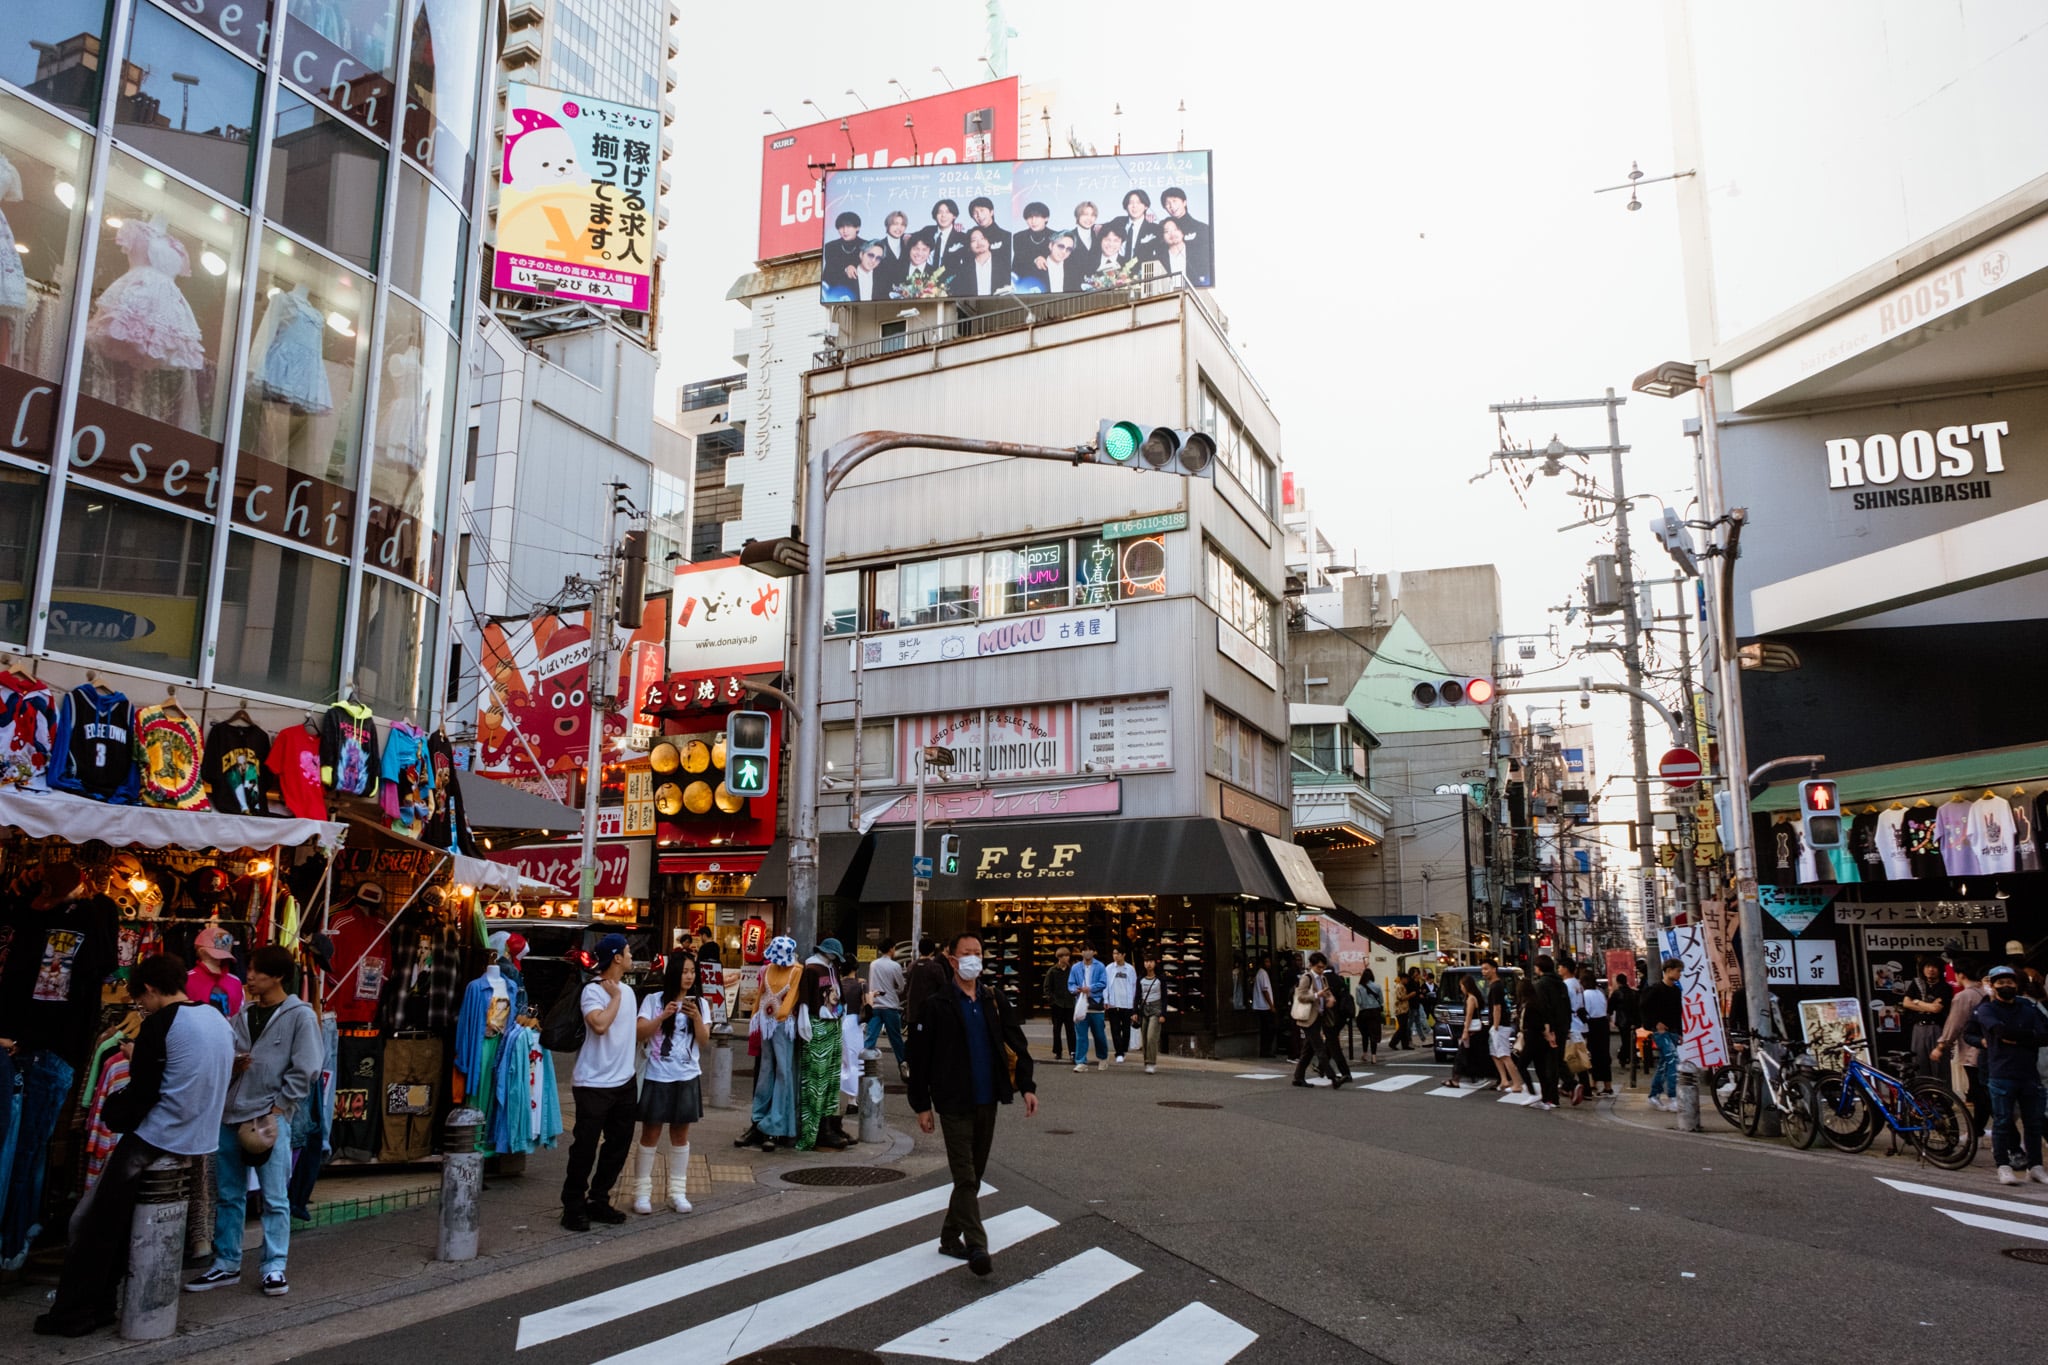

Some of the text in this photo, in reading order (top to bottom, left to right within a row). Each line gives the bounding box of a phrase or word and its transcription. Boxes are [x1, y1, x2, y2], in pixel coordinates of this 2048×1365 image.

[582, 107, 653, 129] いちごなび
[773, 138, 796, 150] KURE
[1129, 159, 1193, 173] 2024.4.24
[939, 169, 1001, 183] 2024.4.24
[1129, 174, 1193, 188] RELEASE
[587, 132, 620, 261] 揃ってます。
[938, 184, 1001, 198] RELEASE
[617, 137, 651, 265] 稼げる求人
[518, 270, 615, 297] いちなび 体入
[1878, 266, 1967, 335] ROOST
[1825, 421, 2009, 490] ROOST
[1853, 480, 1992, 510] SHINSAIBASHI
[1121, 513, 1185, 532] 06-6110-8188
[977, 615, 1047, 656] MUMU
[1059, 618, 1101, 640] 古着屋
[695, 635, 758, 650] www.donaiya.jp
[898, 651, 911, 661] 3F
[647, 676, 743, 704] たこ焼き
[930, 728, 950, 745] USED
[950, 716, 994, 732] CLOTHIG
[1004, 715, 1028, 727] SLECT
[1027, 722, 1048, 738] SHOP
[969, 733, 1004, 743] OSKA
[976, 868, 1075, 880] Face to Face
[1644, 881, 1654, 898] MFC
[1645, 898, 1656, 924] STORE
[1766, 966, 1792, 978] OST
[1810, 967, 1824, 979] 3F
